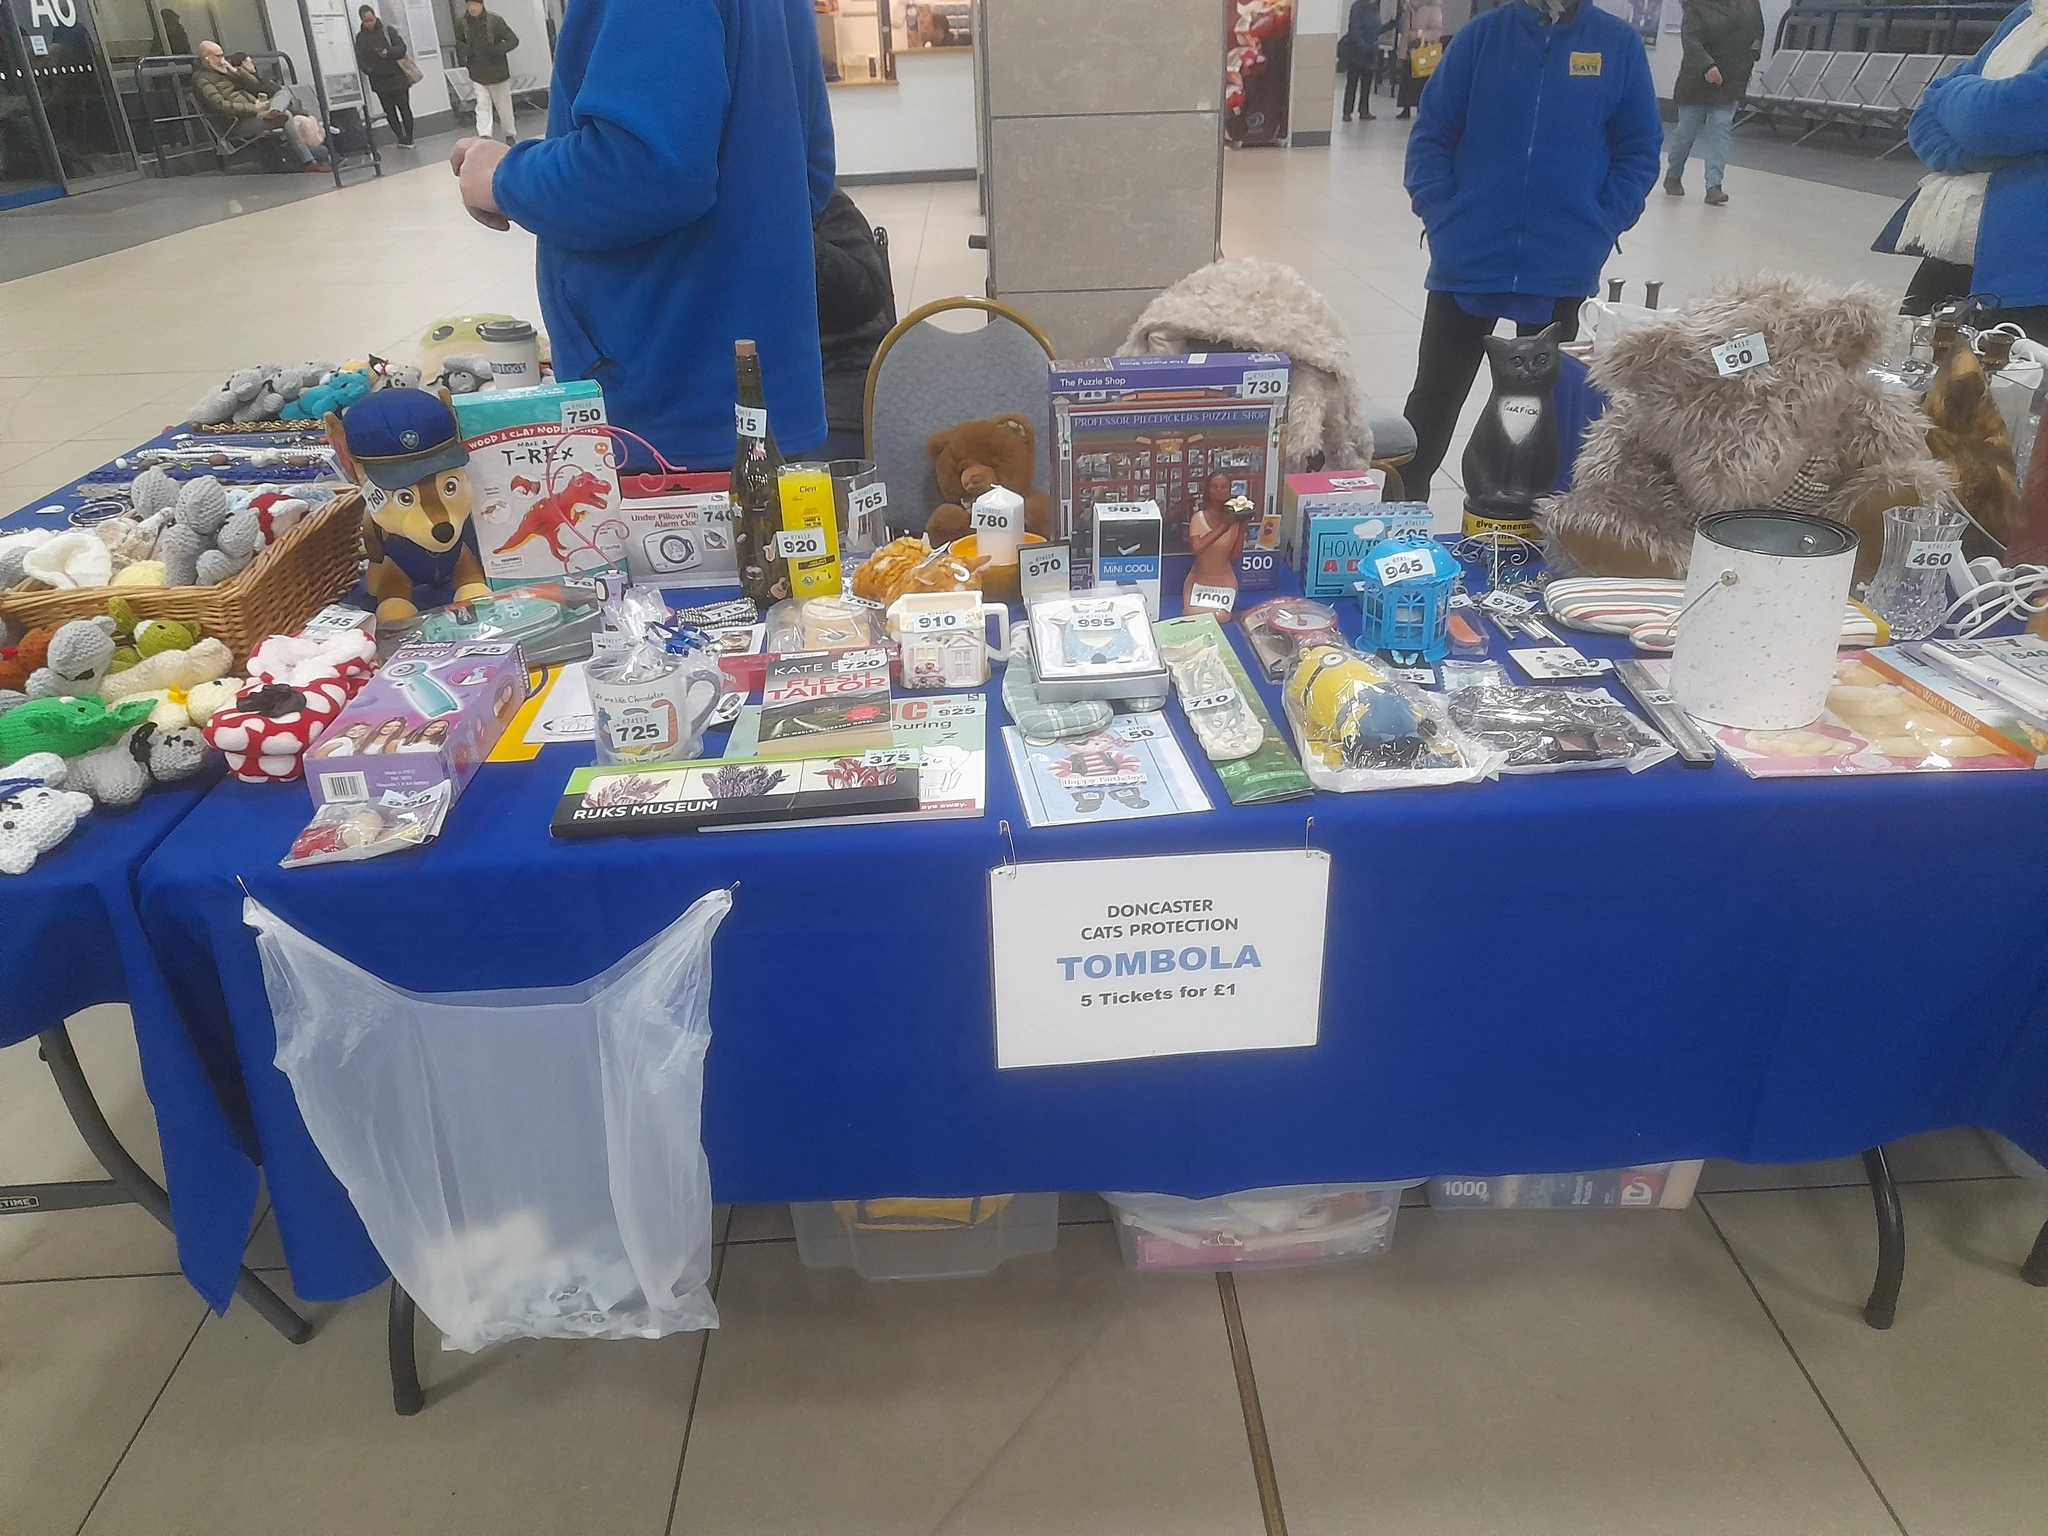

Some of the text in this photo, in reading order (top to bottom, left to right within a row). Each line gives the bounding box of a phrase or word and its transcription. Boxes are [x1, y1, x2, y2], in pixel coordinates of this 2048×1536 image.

[1725, 350, 1753, 368] 90
[1060, 376, 1126, 387] The Puzzle Shop
[1247, 380, 1281, 395] 730
[568, 409, 600, 424] 750
[1074, 410, 1267, 427] PROFESSOR PIECEPICKERS PUZZLE SHOP
[469, 436, 498, 450] WOOD
[501, 434, 508, 442] &
[509, 427, 535, 439] CLAY
[799, 485, 817, 493] Cien
[368, 489, 385, 510] 760
[855, 492, 883, 512] 765
[977, 514, 1008, 528] 780
[784, 540, 817, 553] 920
[1322, 540, 1362, 557] HOW
[1241, 556, 1273, 570] 500
[1323, 560, 1339, 572] A
[1912, 552, 1952, 566] 460
[1029, 558, 1061, 576] 970
[1385, 560, 1423, 579] 945
[1195, 592, 1230, 605] 1000
[1492, 597, 1525, 613] 975
[318, 616, 354, 627] 745
[919, 615, 956, 628] 910
[1078, 618, 1115, 627] 995
[397, 650, 450, 659] Crazy
[774, 663, 824, 676] KATE
[844, 660, 880, 669] 720
[787, 671, 871, 688] FLESH
[767, 677, 886, 700] TAILOR
[1190, 695, 1228, 707] 710
[938, 707, 976, 716] 925
[1922, 689, 1947, 711] Watch
[1948, 705, 1980, 731] Wildlife
[616, 723, 660, 741] 725
[1129, 729, 1154, 739] 50
[869, 753, 910, 765] 375
[1220, 765, 1237, 777] 12
[631, 800, 718, 816] MUSEUM
[1107, 899, 1213, 918] DONCASTER
[1080, 918, 1239, 940] CATS PROTECTION
[1056, 944, 1262, 981] TOMBOLA
[1080, 983, 1236, 1007] 5 Tickets for £1
[1443, 1181, 1488, 1196] 1000
